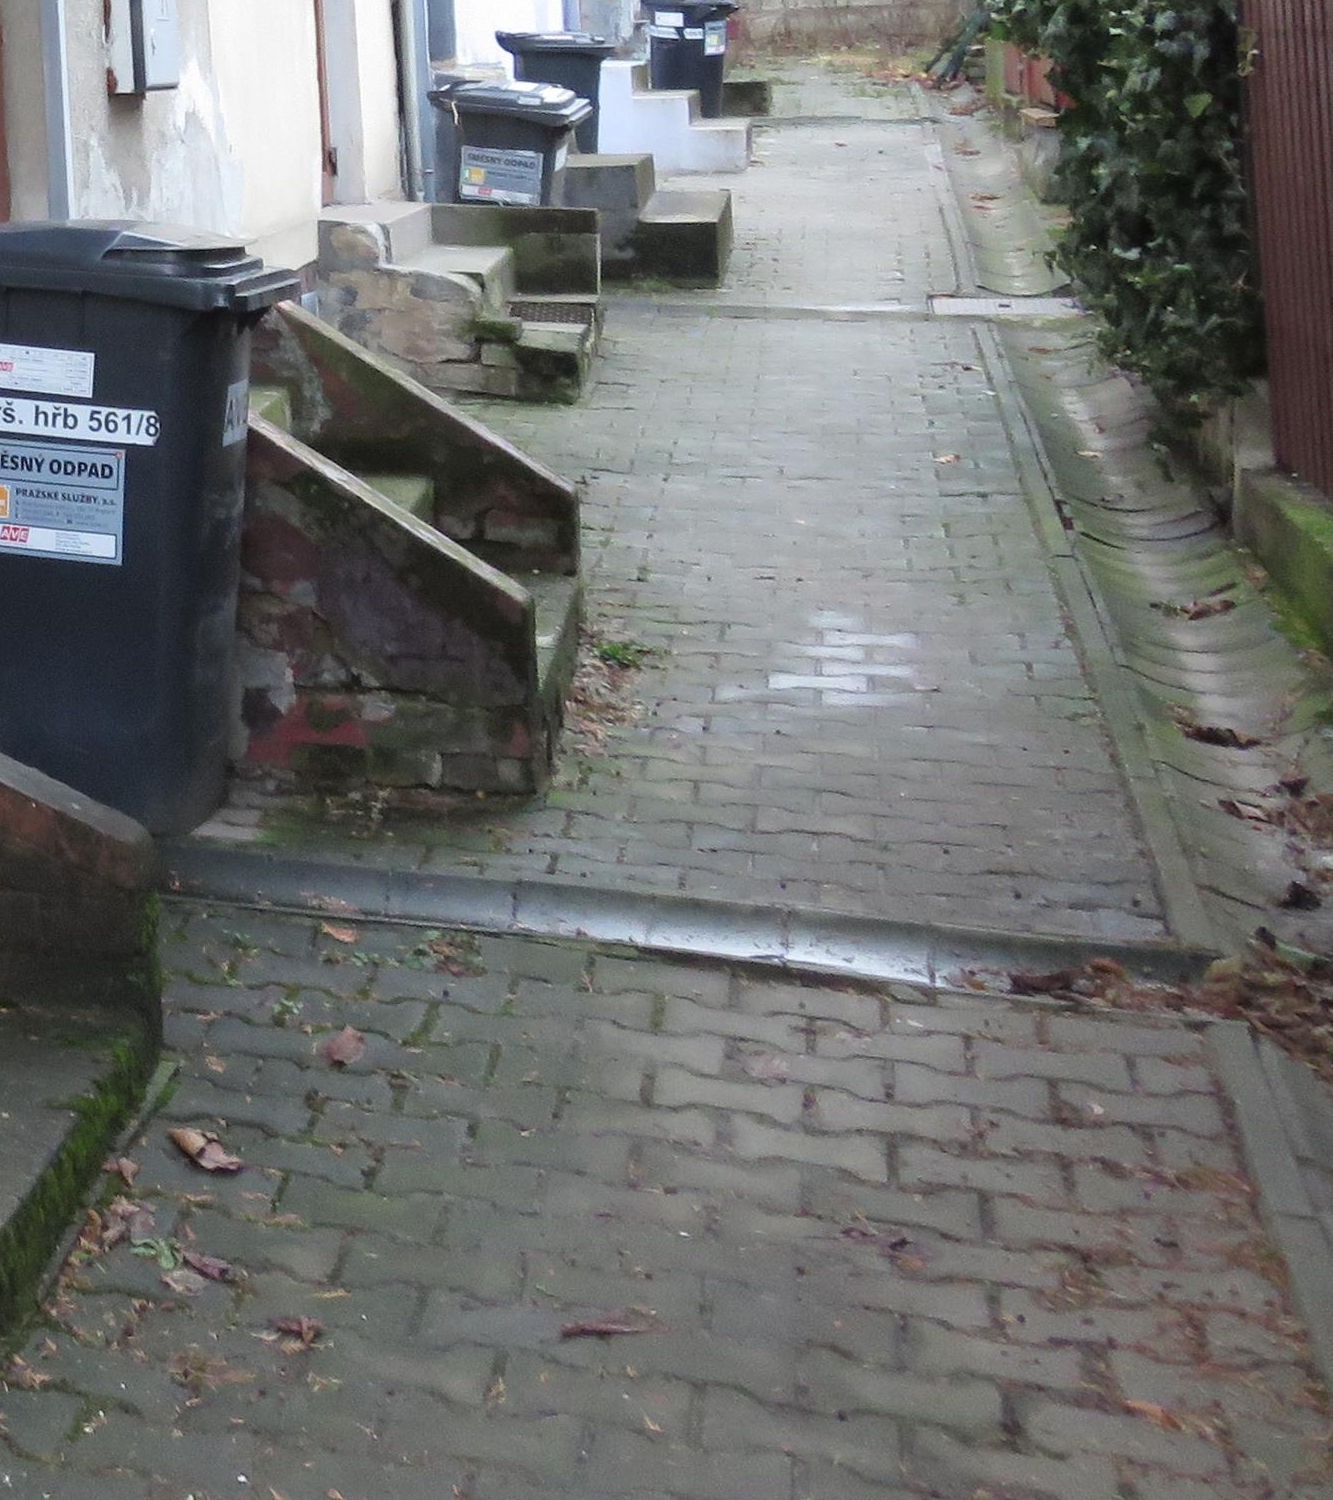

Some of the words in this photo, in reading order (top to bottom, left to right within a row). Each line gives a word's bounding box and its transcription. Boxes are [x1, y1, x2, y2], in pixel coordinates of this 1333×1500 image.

[34, 404, 78, 430] hřb
[88, 410, 159, 437] 561/8
[48, 458, 114, 480] ODPAD
[0, 526, 30, 543] AVE
